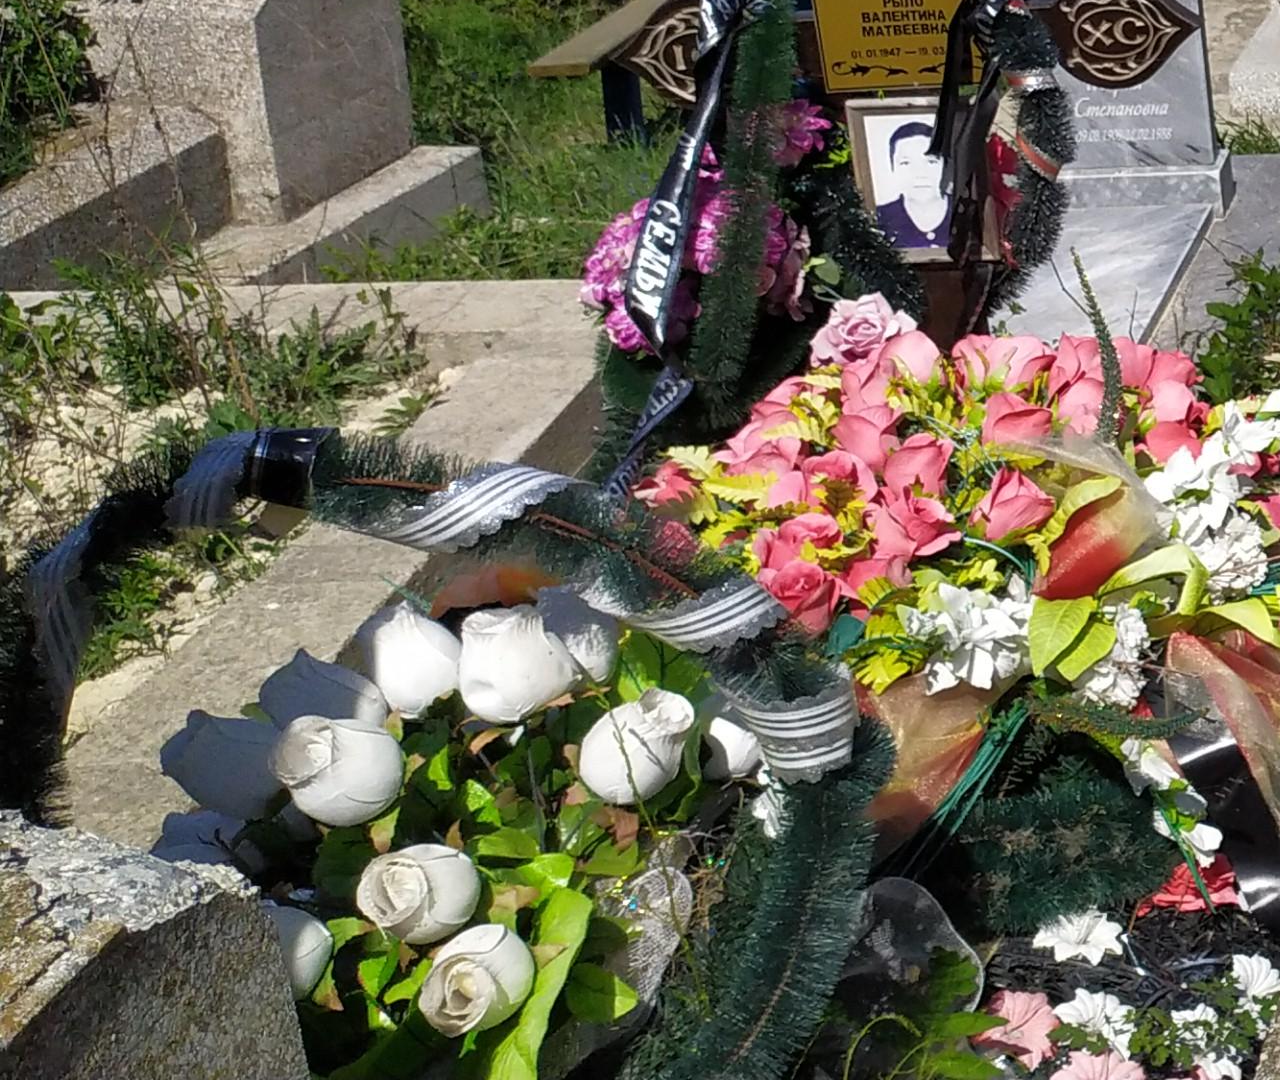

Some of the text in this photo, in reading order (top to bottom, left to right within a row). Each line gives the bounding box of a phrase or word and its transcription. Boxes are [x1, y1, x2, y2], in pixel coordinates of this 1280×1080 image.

[861, 10, 946, 23] ВАЛЕНТИНА
[861, 23, 950, 37] МАТВЕЕВНА
[1074, 97, 1169, 118] Степановна
[631, 199, 682, 319] СЕМЬИ
